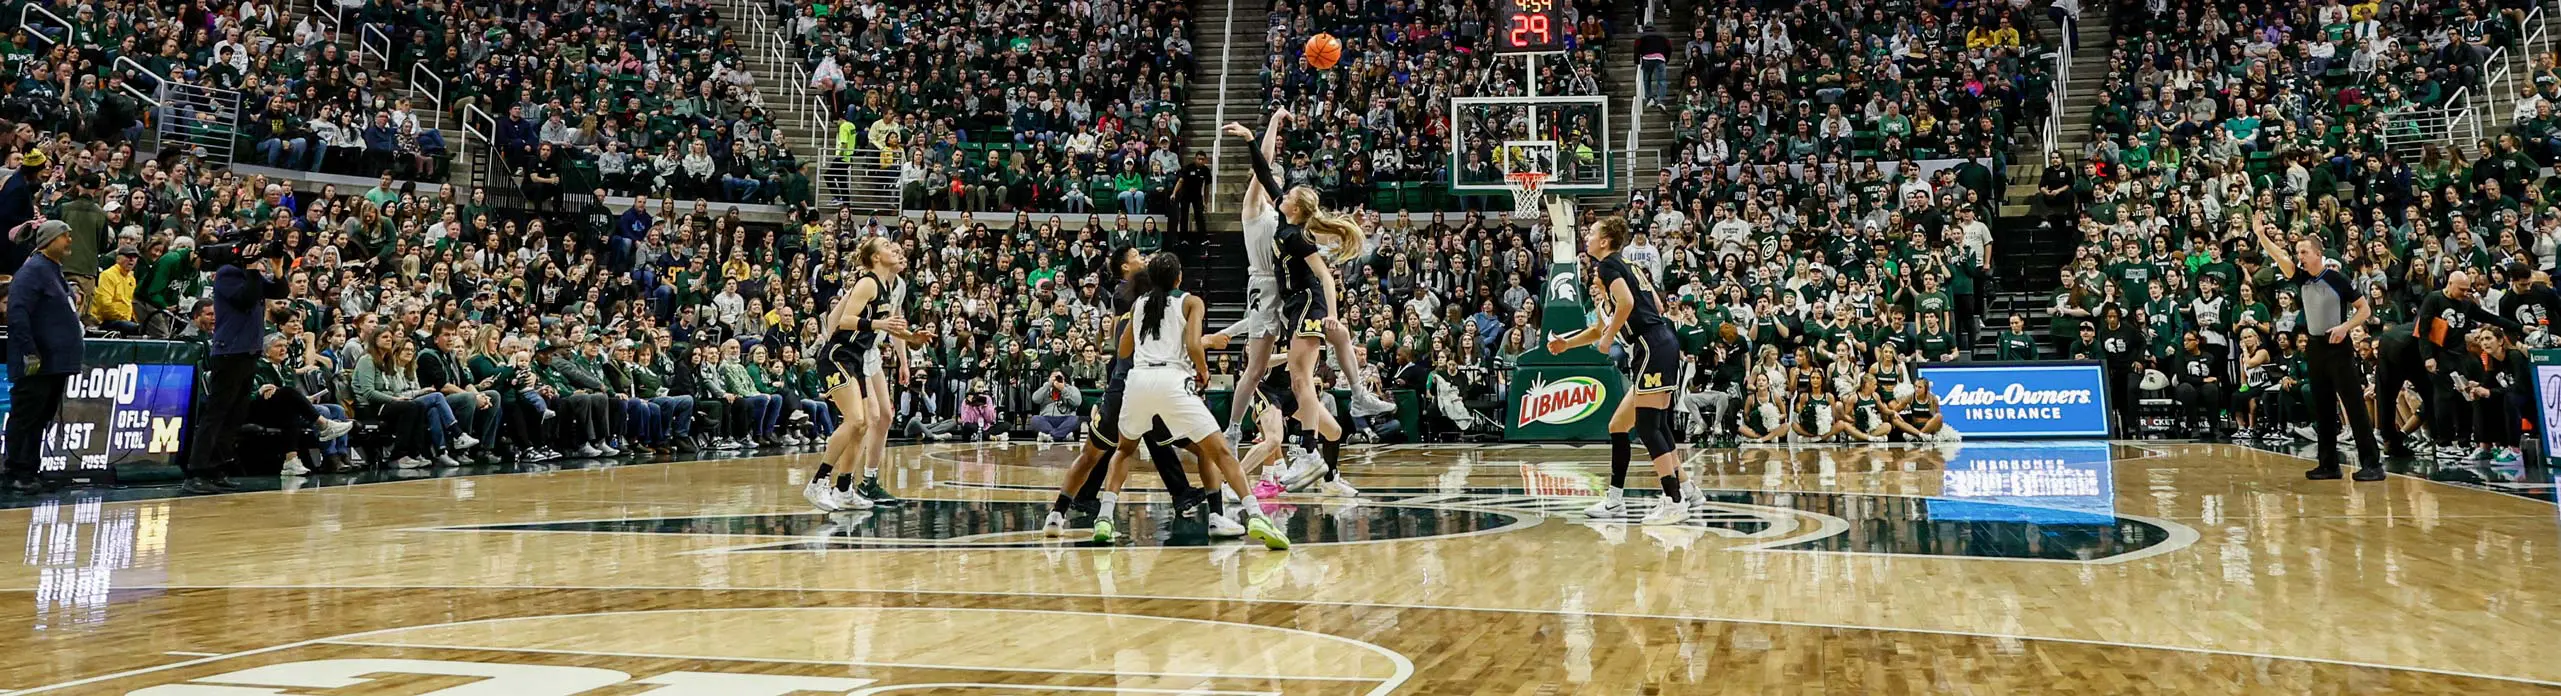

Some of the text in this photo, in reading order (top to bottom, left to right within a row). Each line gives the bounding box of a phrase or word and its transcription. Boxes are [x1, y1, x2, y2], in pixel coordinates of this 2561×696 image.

[1511, 15, 1548, 46] 29
[1304, 319, 1322, 332] M
[826, 372, 841, 389] M
[1644, 372, 1662, 388] M
[1938, 383, 2090, 405] Auto-Owners
[1520, 384, 1597, 425] LIBMAN
[1965, 407, 2062, 420] INSURANCE
[2140, 418, 2175, 426] ROCKET
[148, 416, 183, 453] M
